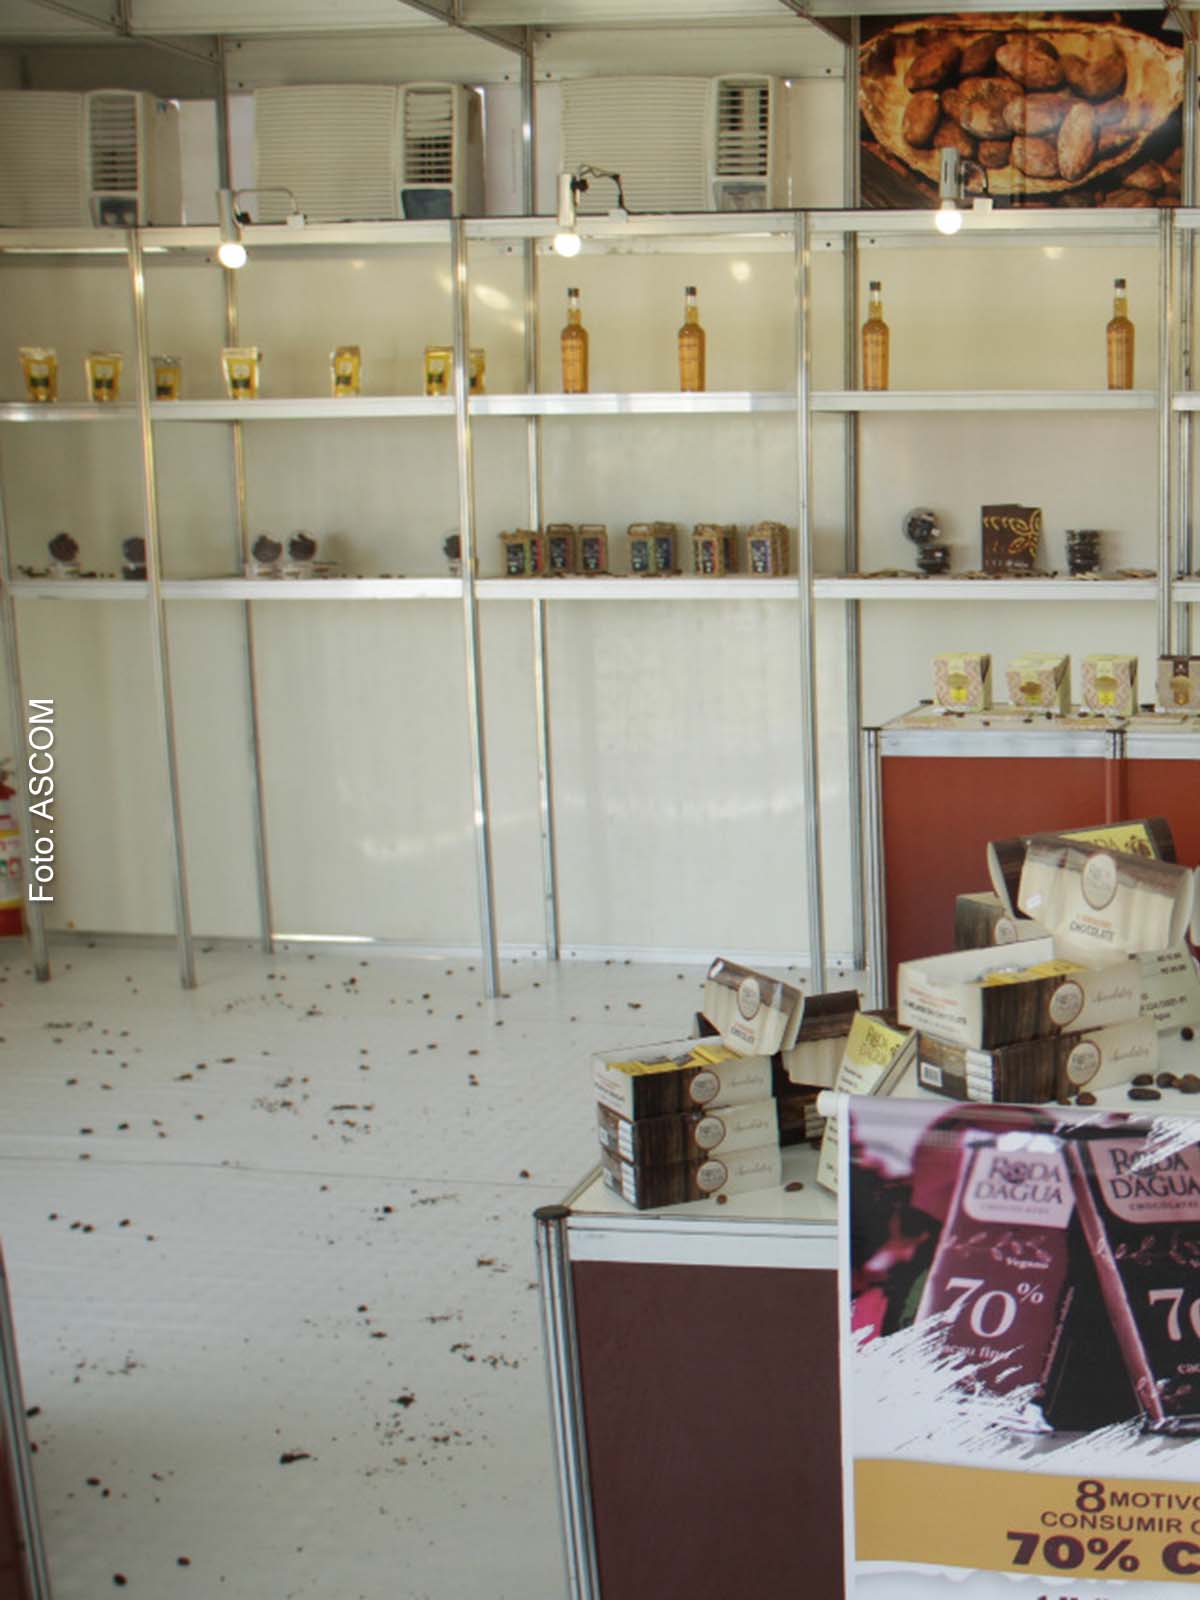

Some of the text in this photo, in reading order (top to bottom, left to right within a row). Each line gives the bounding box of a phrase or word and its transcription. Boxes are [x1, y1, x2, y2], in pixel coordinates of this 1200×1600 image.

[990, 1156, 1062, 1184] RODA
[944, 1276, 1045, 1339] 70%
[1075, 1479, 1106, 1513] 8
[1040, 1511, 1183, 1534] CONSUMIR
[1006, 1531, 1140, 1573] 70%
